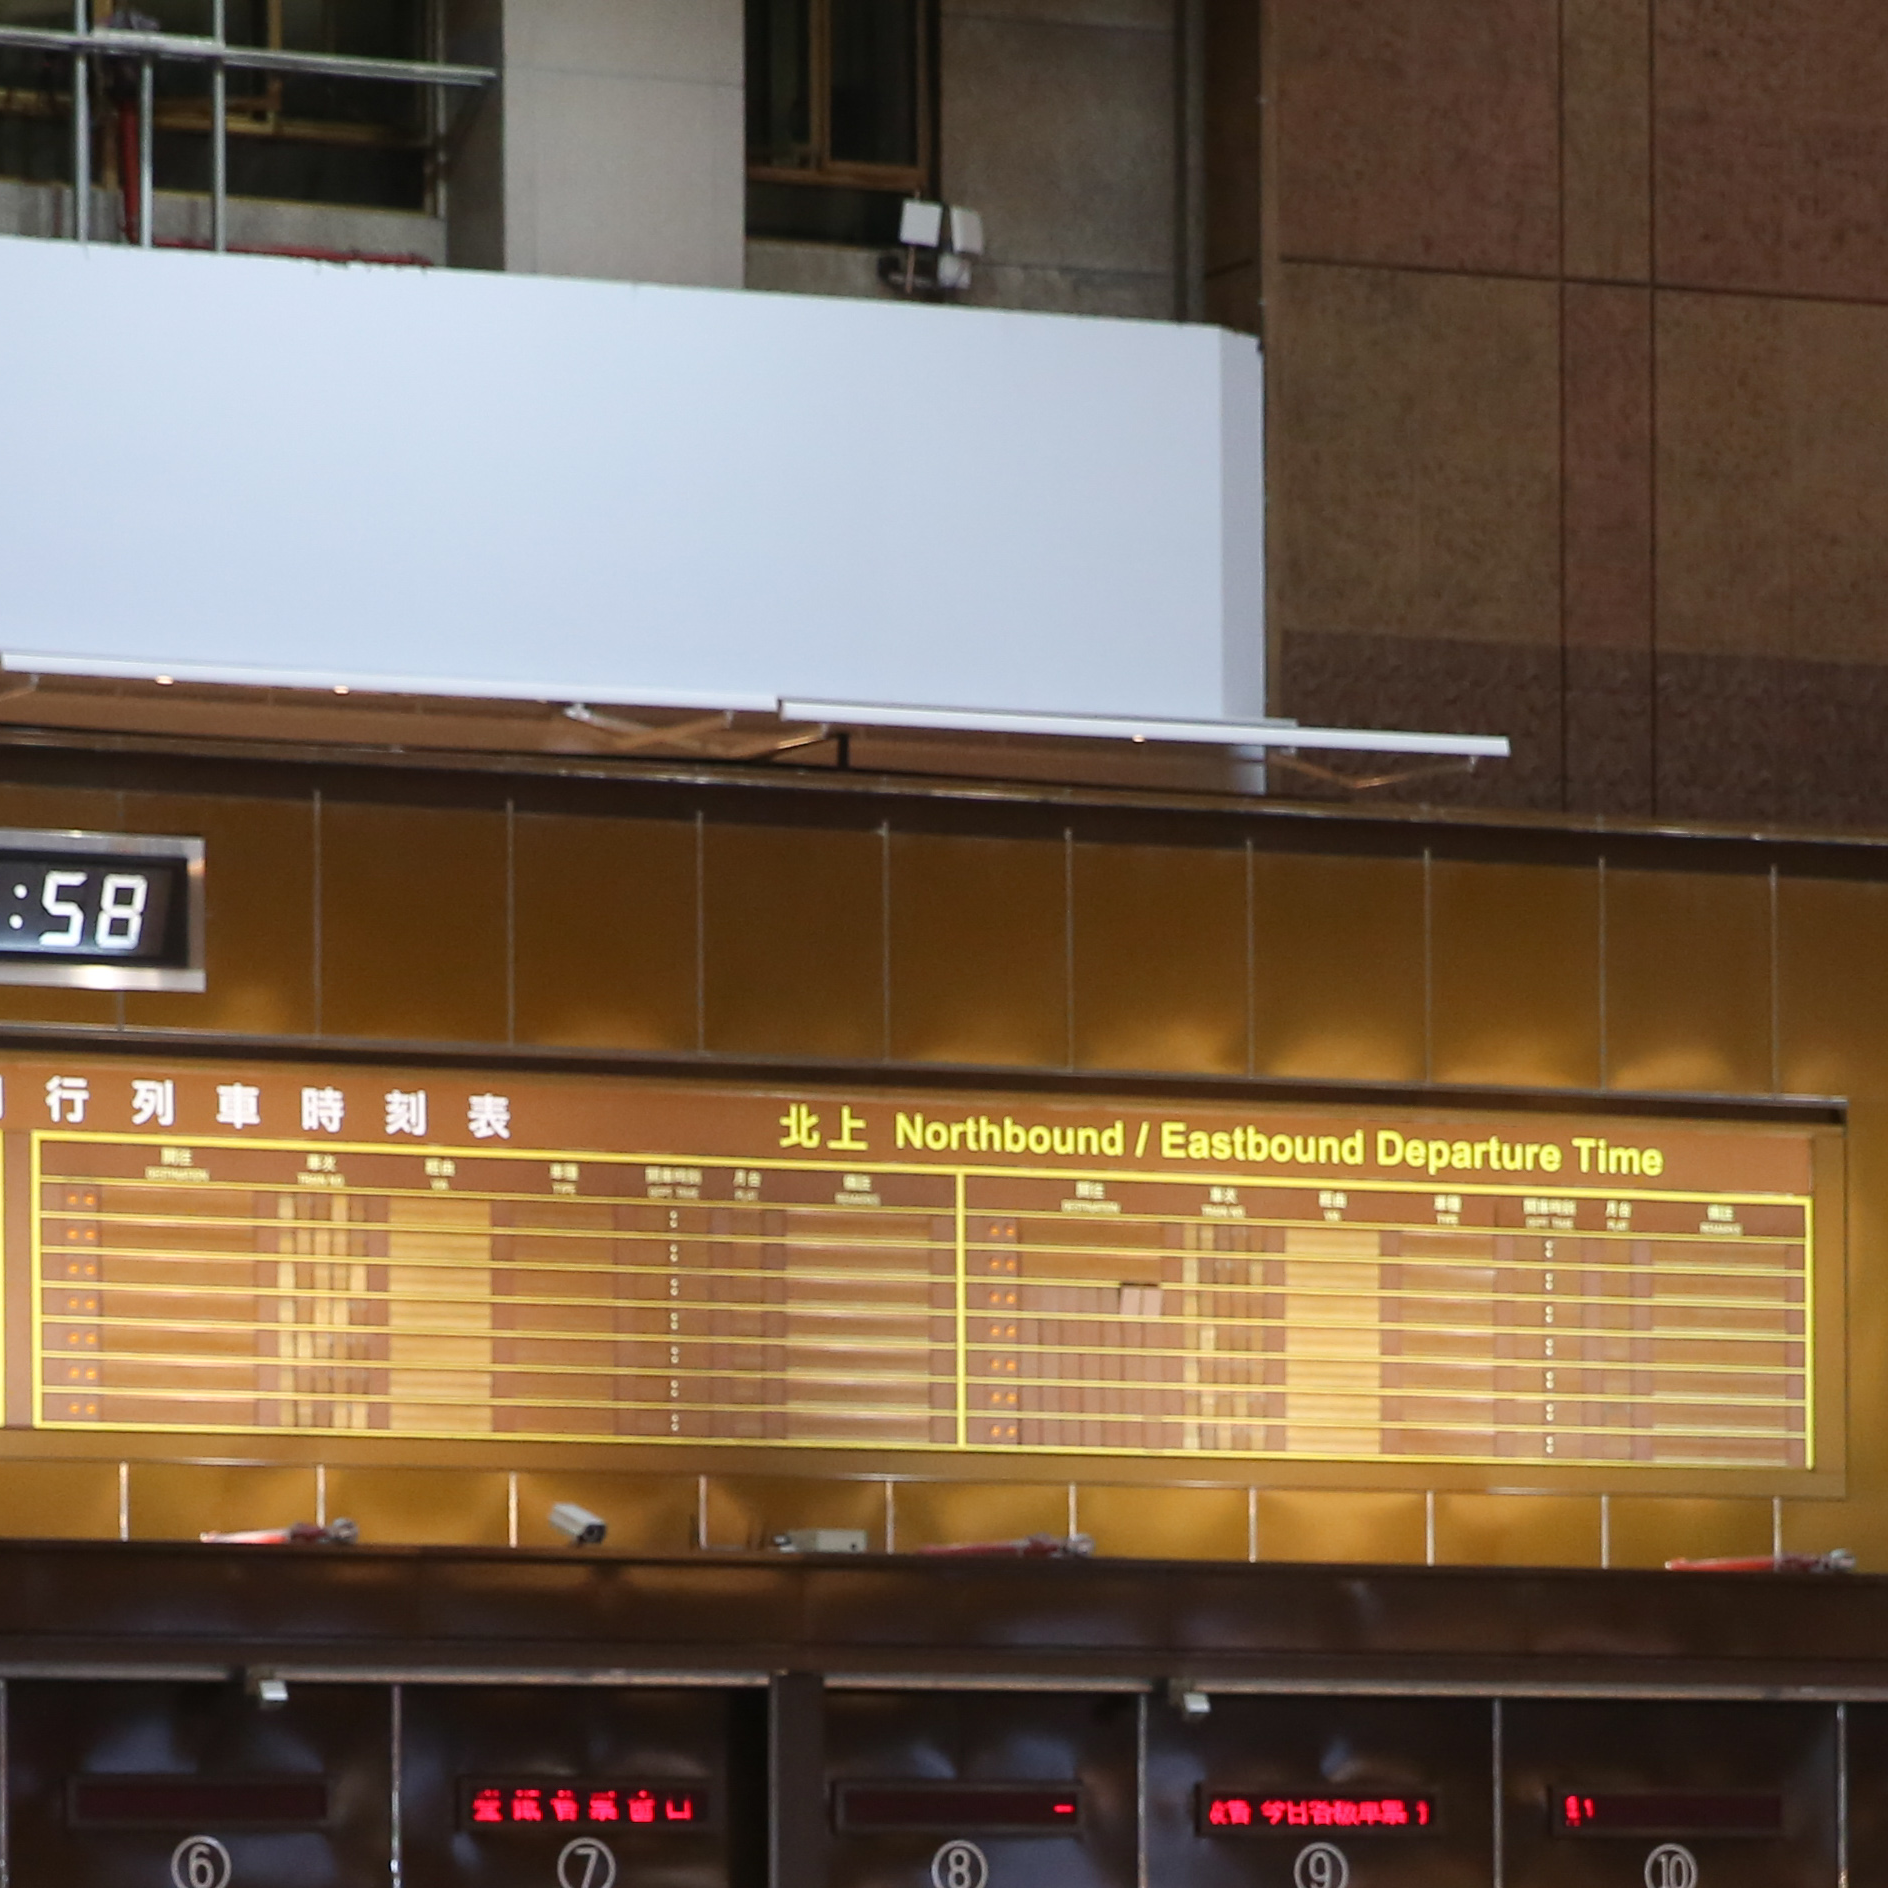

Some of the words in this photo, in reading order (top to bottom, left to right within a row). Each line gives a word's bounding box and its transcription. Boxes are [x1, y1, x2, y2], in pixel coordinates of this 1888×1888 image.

[779, 1102, 870, 1152] 北上
[894, 1112, 1125, 1157] Northbound
[1159, 1121, 1365, 1166] Eastbound
[1375, 1129, 1564, 1176] Departure
[1577, 1136, 1665, 1175] Time
